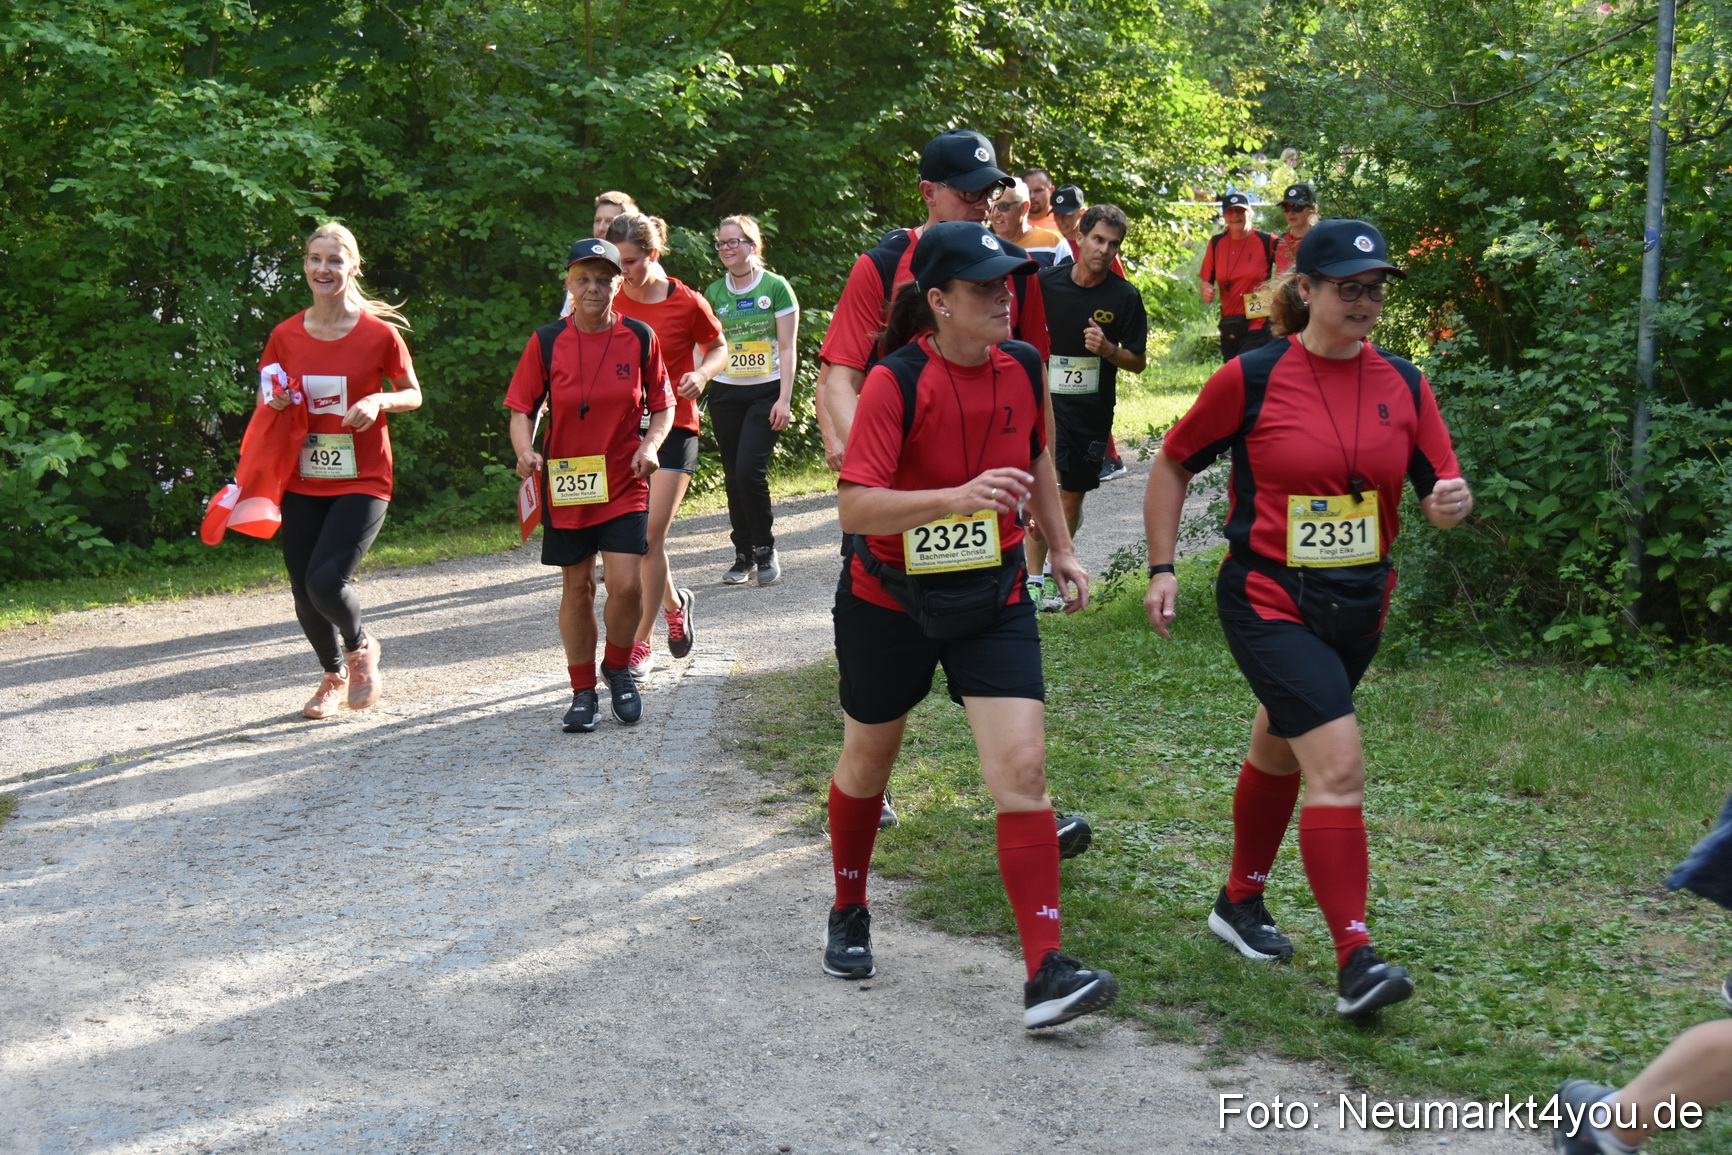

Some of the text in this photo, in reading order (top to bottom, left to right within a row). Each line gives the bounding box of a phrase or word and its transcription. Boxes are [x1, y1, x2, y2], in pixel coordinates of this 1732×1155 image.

[1249, 301, 1262, 311] 23
[731, 353, 766, 367] 2088
[616, 363, 631, 376] 24
[1064, 370, 1083, 384] 73
[1004, 406, 1013, 426] 7
[1377, 403, 1389, 419] 8
[310, 449, 342, 466] 492
[556, 472, 598, 493] 2357
[914, 521, 987, 553] 2325
[1299, 518, 1366, 547] 2331
[920, 548, 987, 561] Bachmeier Christa
